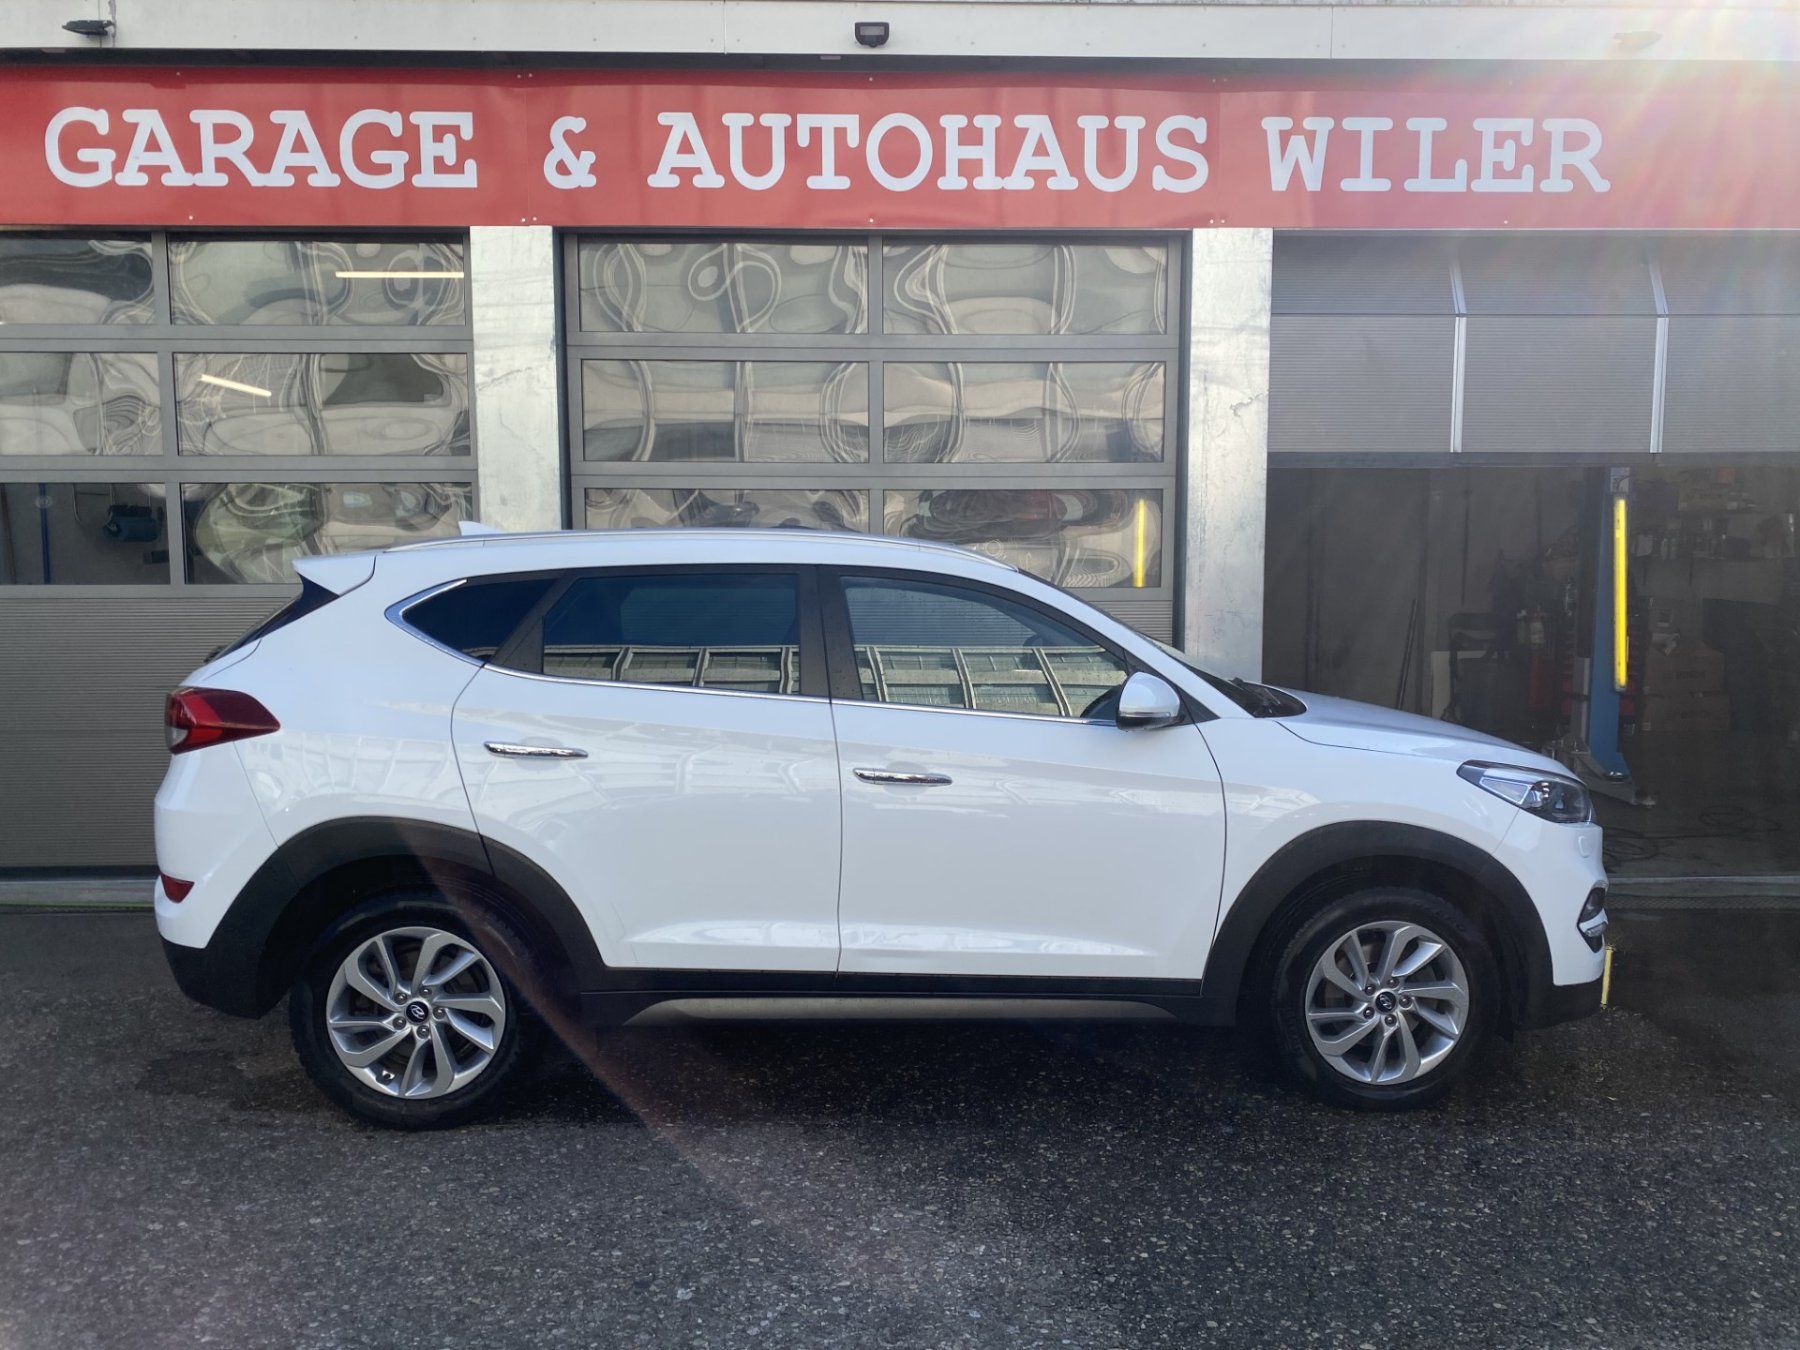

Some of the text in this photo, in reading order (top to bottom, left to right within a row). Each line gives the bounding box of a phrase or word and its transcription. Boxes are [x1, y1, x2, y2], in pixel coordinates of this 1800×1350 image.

[45, 107, 1612, 194] GARAGE & AUTOHAUS WILER
